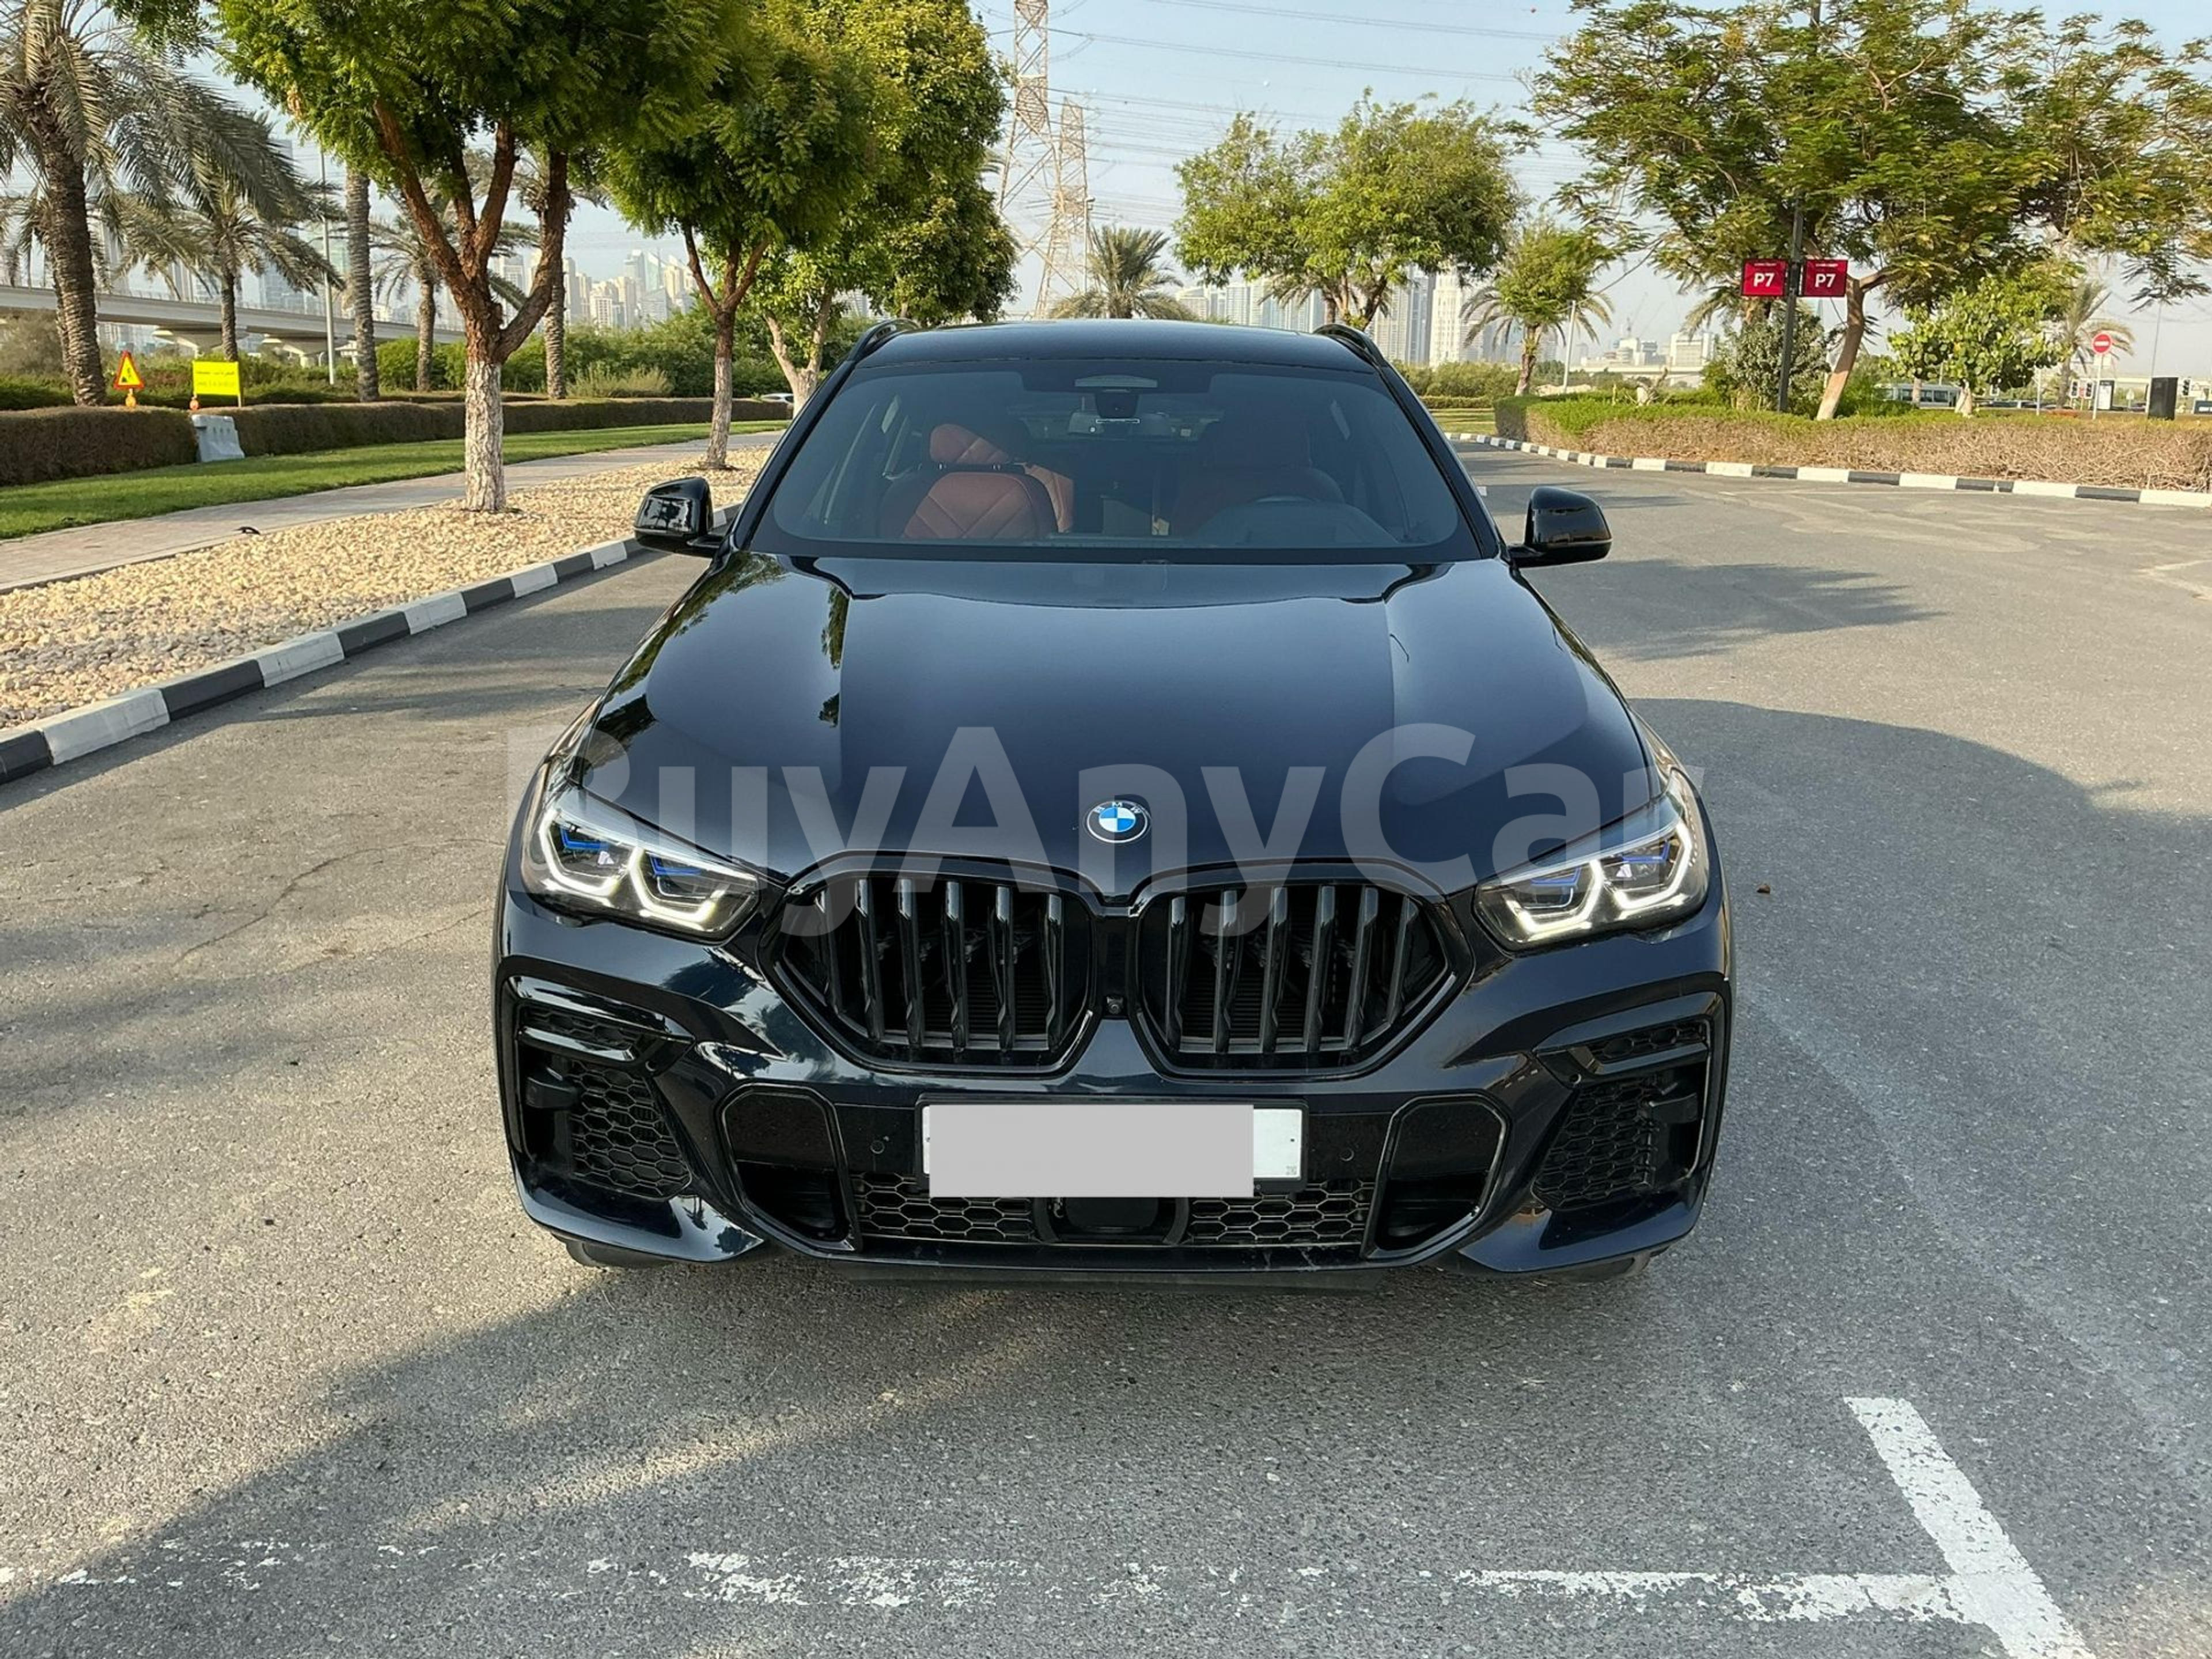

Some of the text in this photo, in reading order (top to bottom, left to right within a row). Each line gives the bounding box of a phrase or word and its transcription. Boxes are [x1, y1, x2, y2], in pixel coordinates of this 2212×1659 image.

[1753, 272, 1775, 287] P7
[1815, 273, 1836, 287] P7
[1093, 801, 1143, 813] BMW
